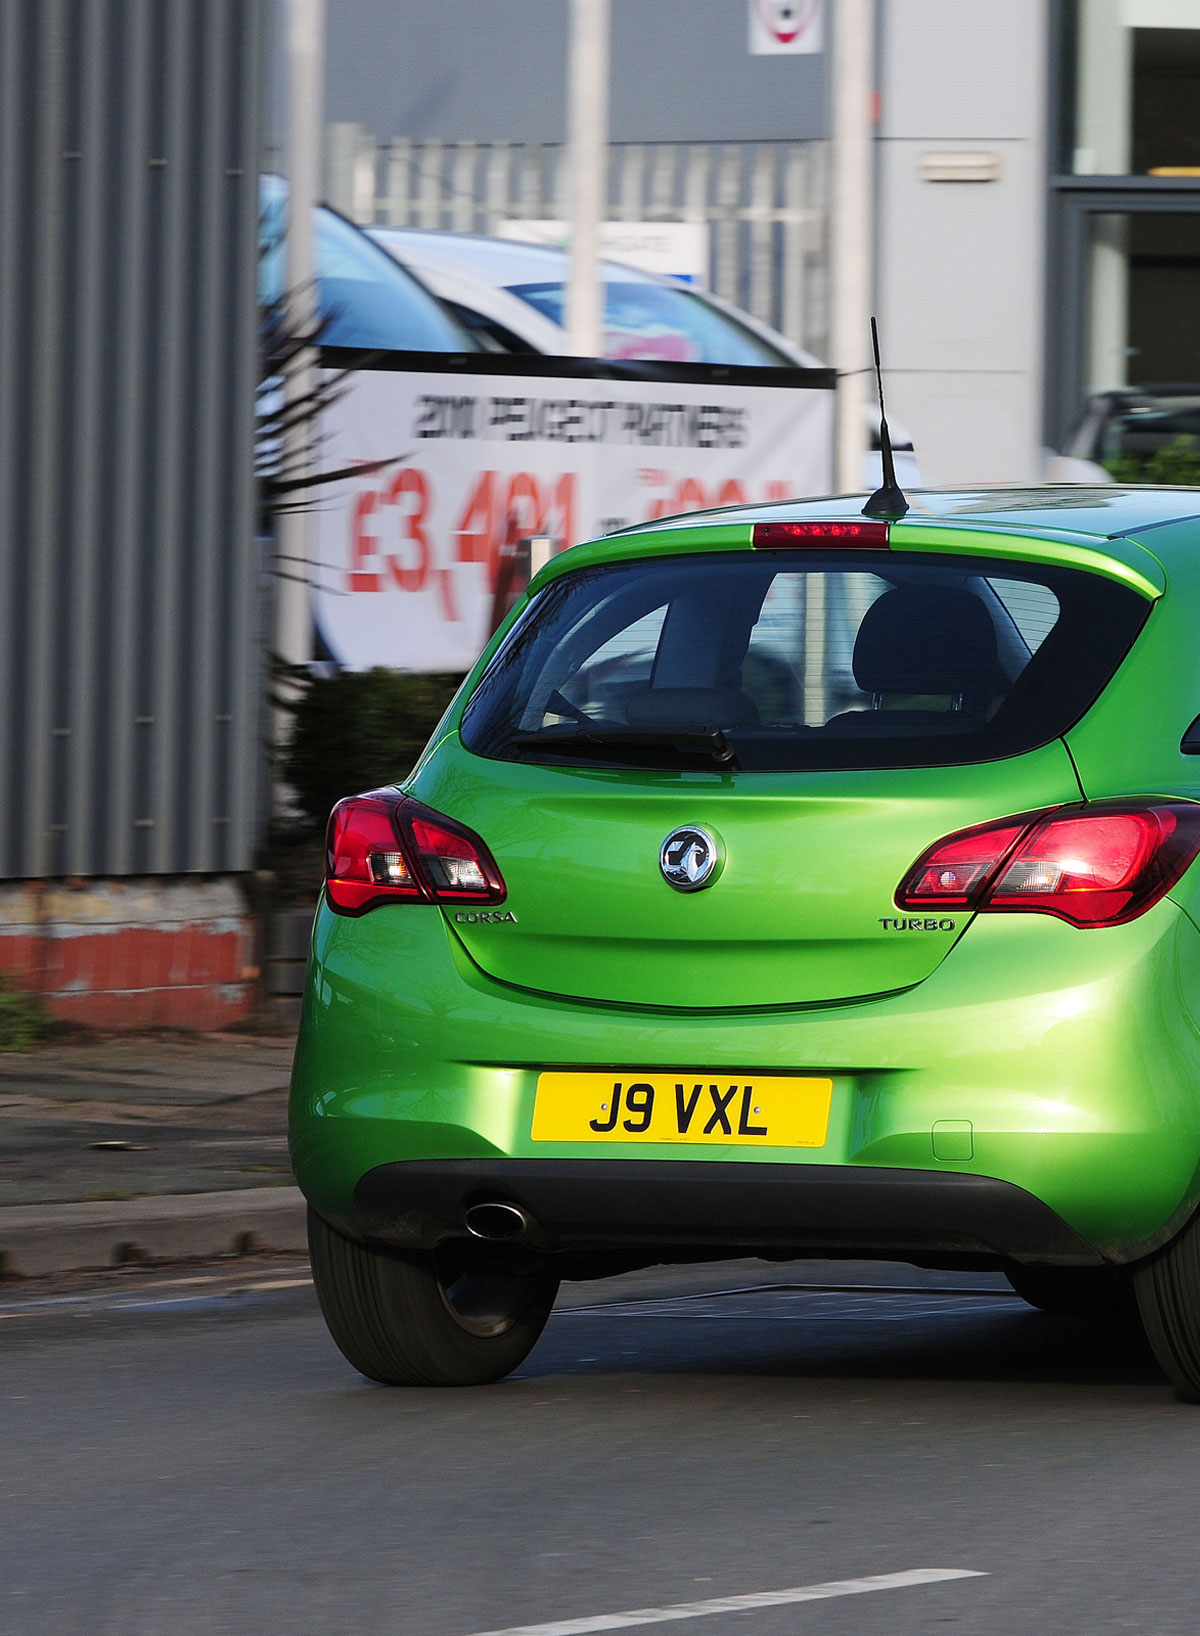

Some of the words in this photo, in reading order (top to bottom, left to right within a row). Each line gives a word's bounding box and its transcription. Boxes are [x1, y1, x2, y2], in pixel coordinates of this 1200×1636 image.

[455, 911, 518, 924] CORSA
[878, 918, 955, 931] TURBO
[589, 1083, 655, 1133] J9
[675, 1084, 768, 1136] VXL
